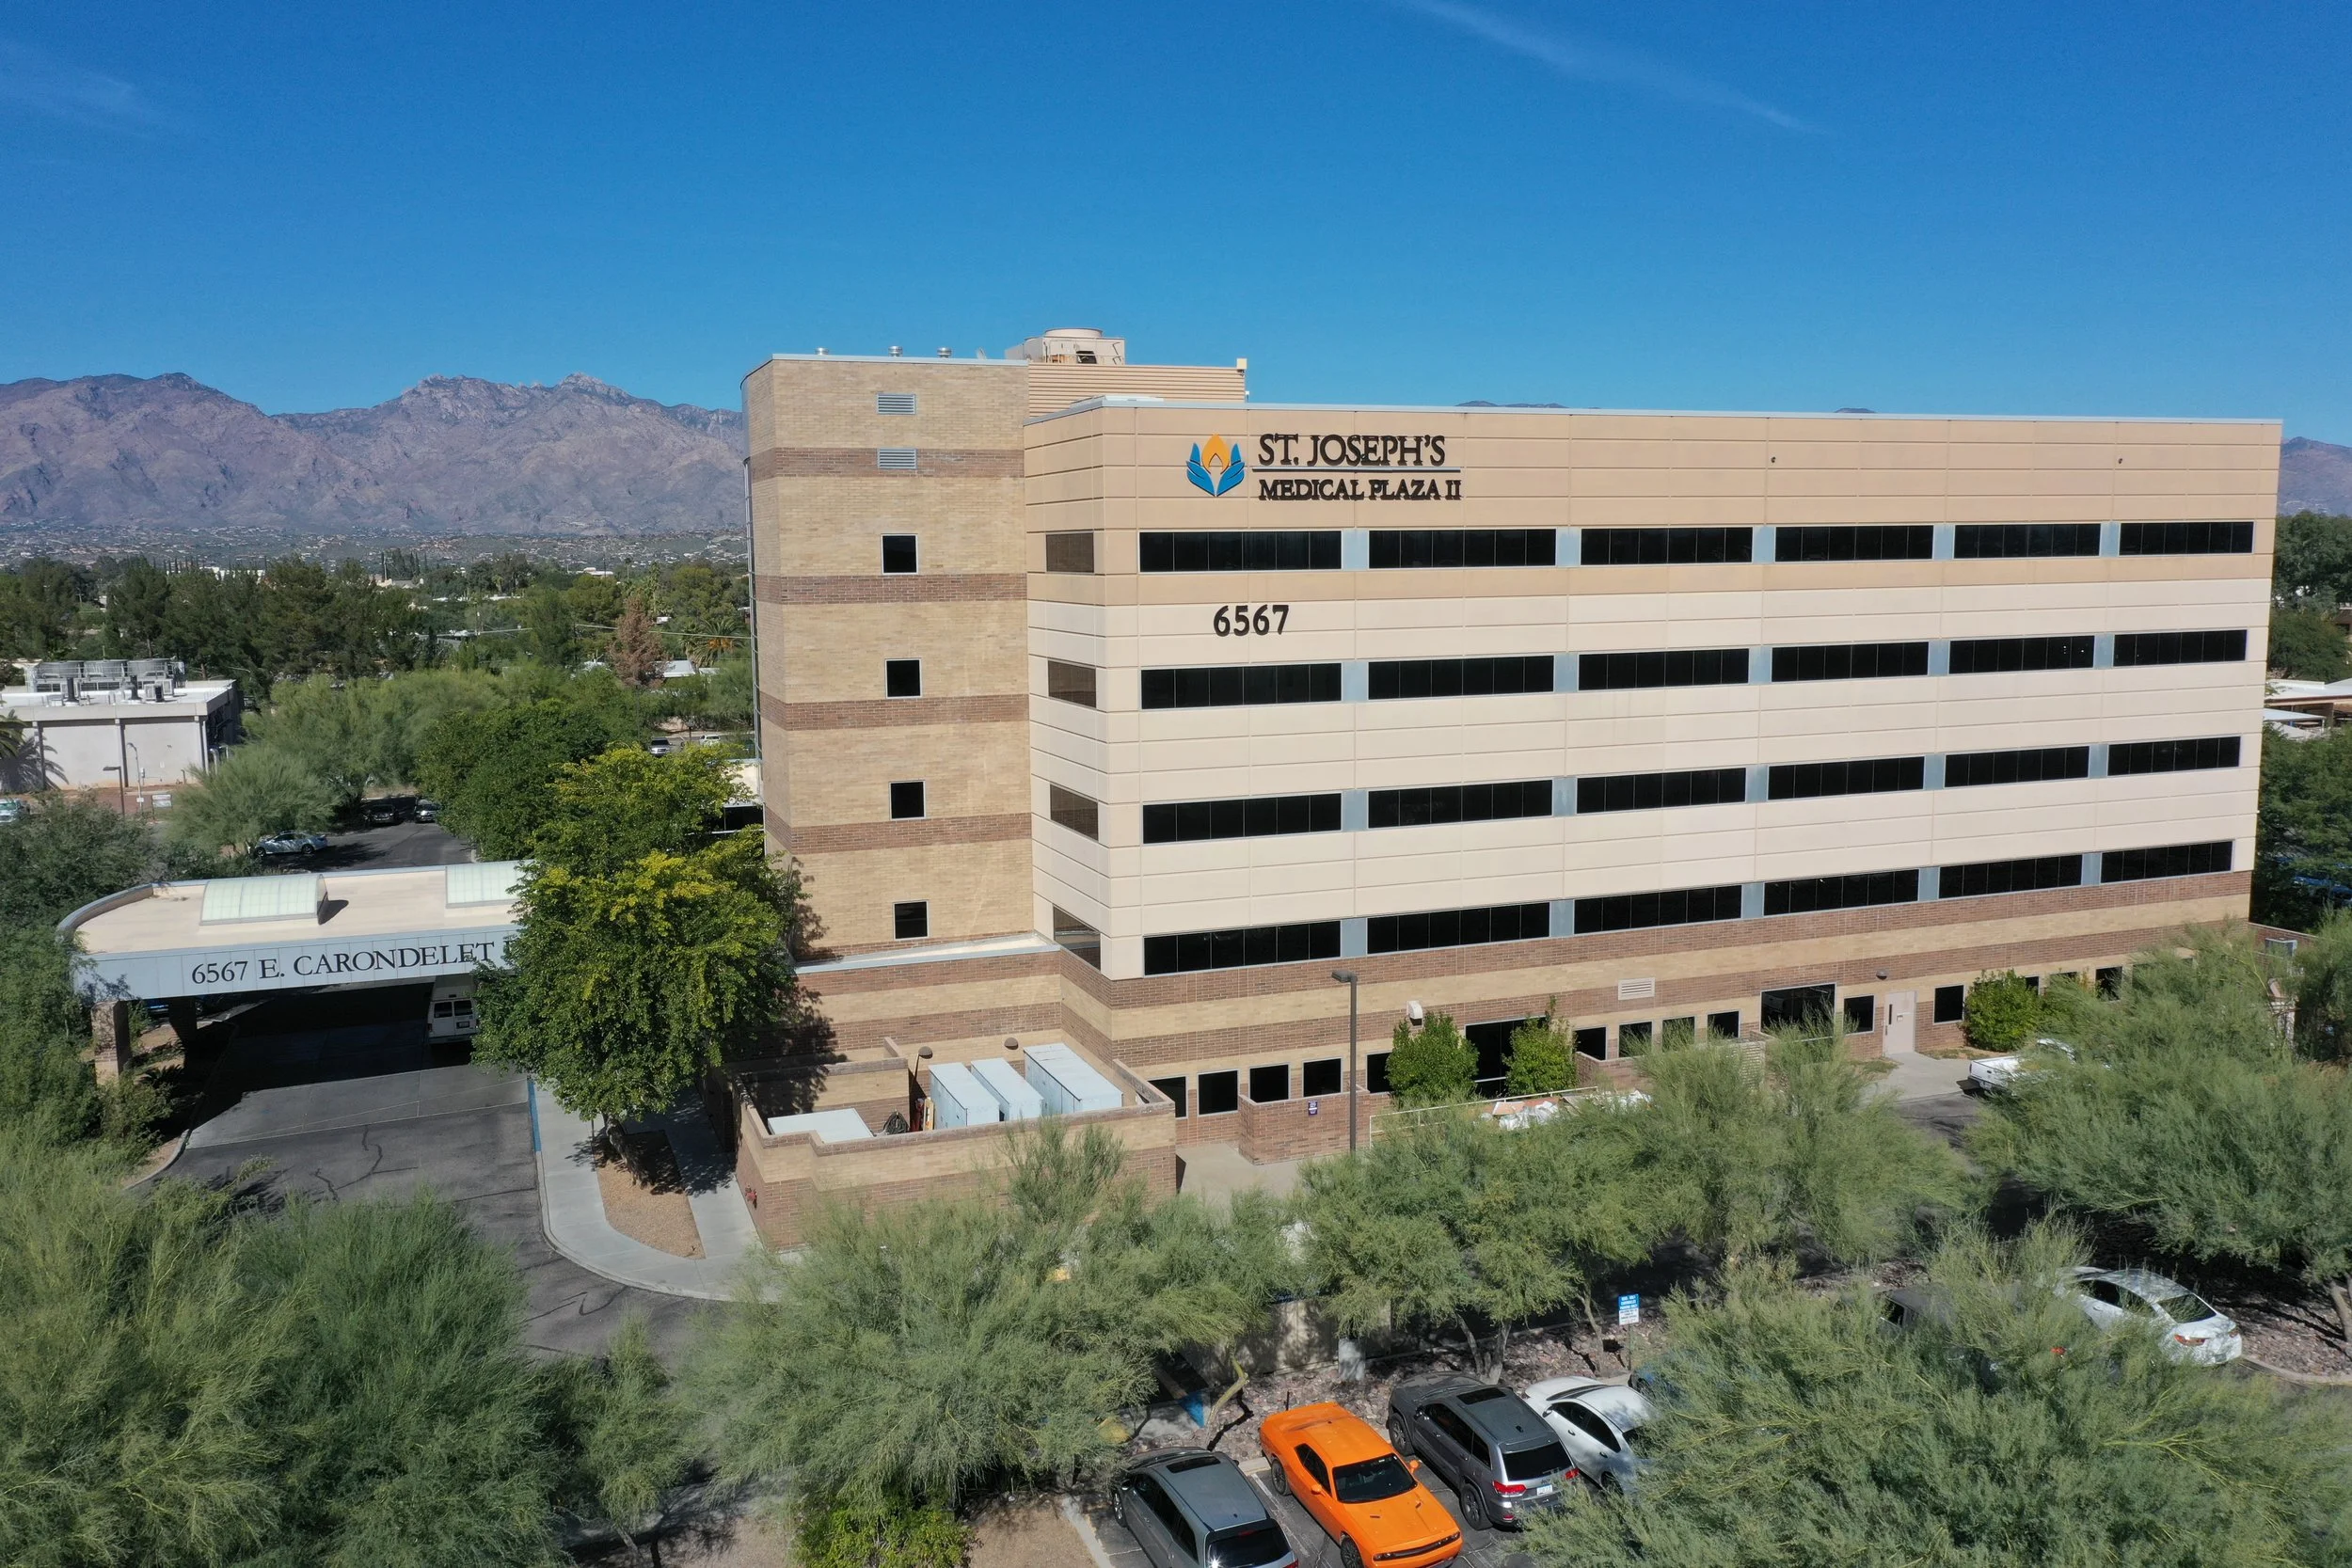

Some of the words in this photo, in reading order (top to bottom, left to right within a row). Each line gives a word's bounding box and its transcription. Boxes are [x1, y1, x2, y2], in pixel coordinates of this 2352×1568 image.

[1258, 434, 1299, 467] ST.
[1307, 434, 1445, 467] JOSEPH'S
[1259, 479, 1365, 500] MEDICAL
[1368, 479, 1442, 500] PLAZA
[1445, 479, 1462, 500] II
[1213, 604, 1289, 637] 6567
[191, 960, 248, 985] 6567
[259, 958, 285, 979] E.
[294, 942, 495, 975] CARONDELET
